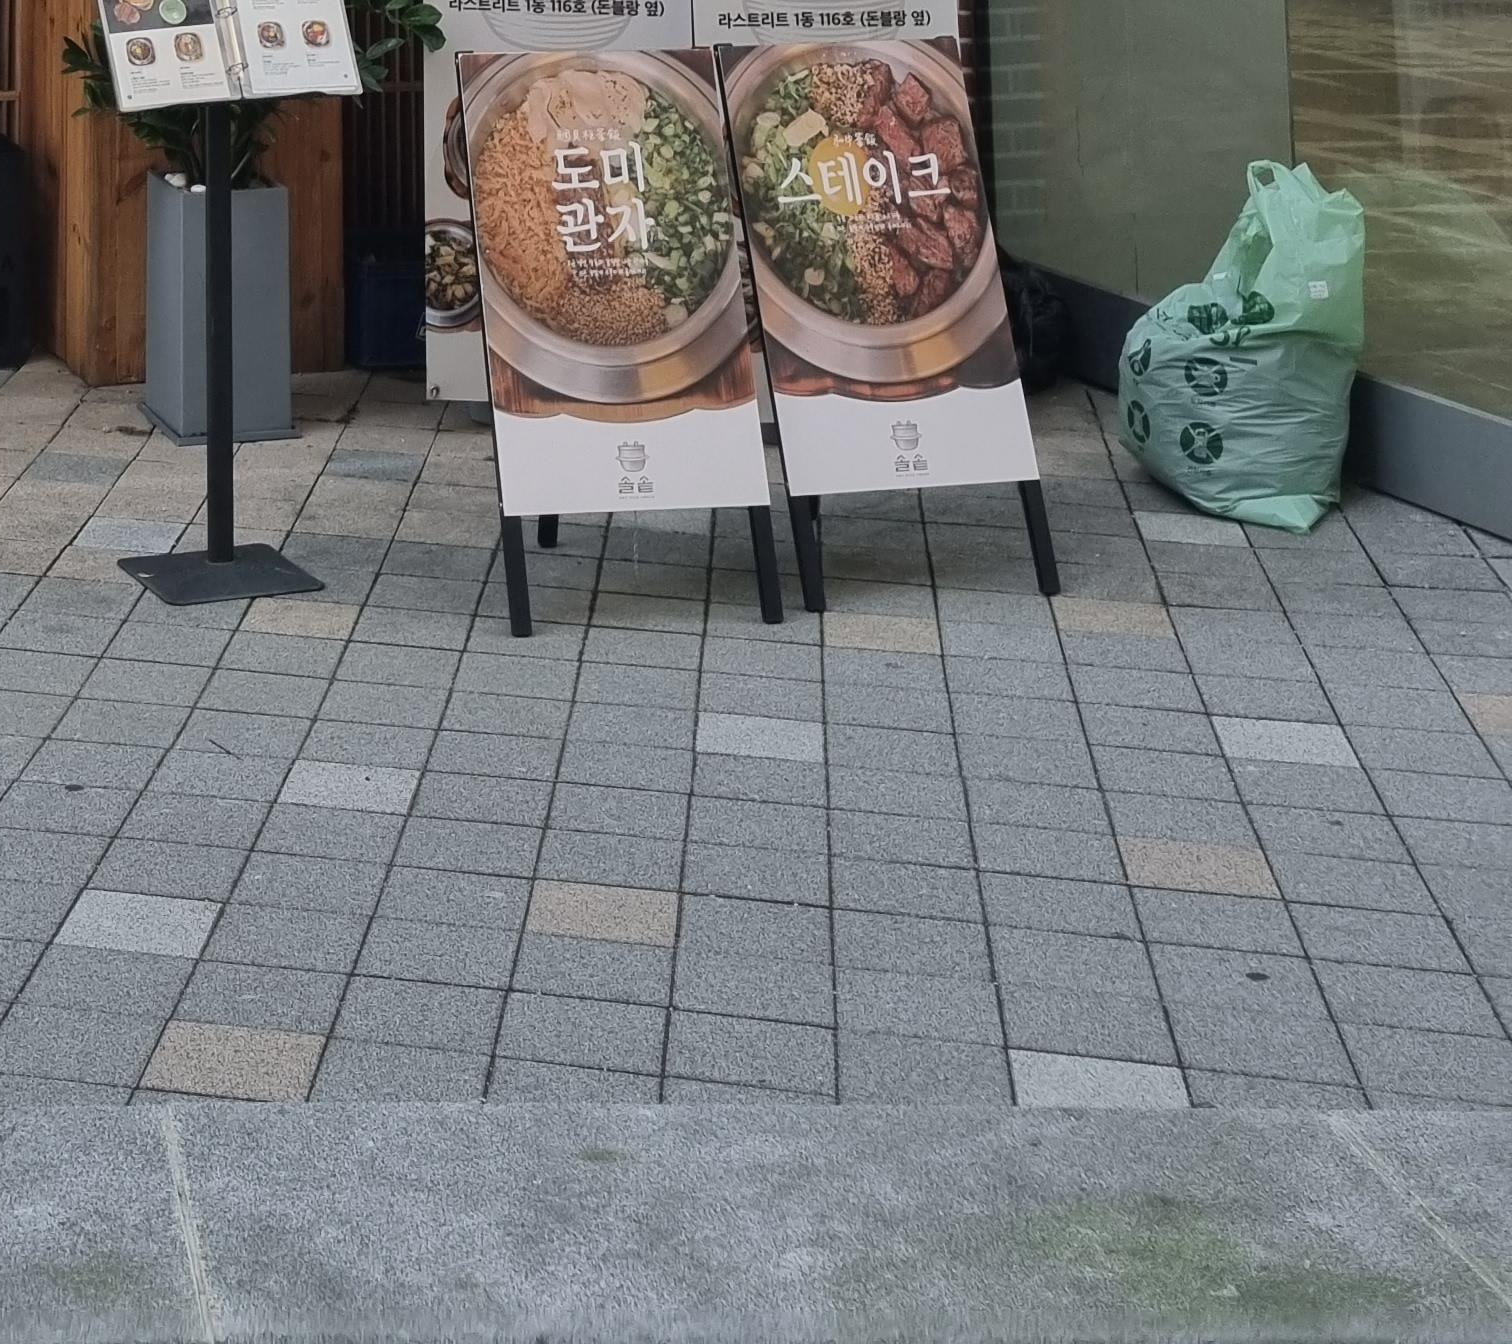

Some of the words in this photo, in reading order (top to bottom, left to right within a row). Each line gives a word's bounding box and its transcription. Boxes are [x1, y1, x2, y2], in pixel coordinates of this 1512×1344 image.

[551, 0, 587, 14] 116호
[644, 0, 665, 17] 옆)
[718, 12, 790, 29] 라스트리트
[794, 12, 815, 27] 1동
[819, 11, 856, 27] 116호
[911, 10, 931, 26] 옆)
[551, 140, 645, 193] 도미
[778, 149, 951, 206] 스테이크
[554, 197, 656, 253] 관자
[894, 453, 929, 472] 솔솥
[618, 475, 654, 494] 솔솥
